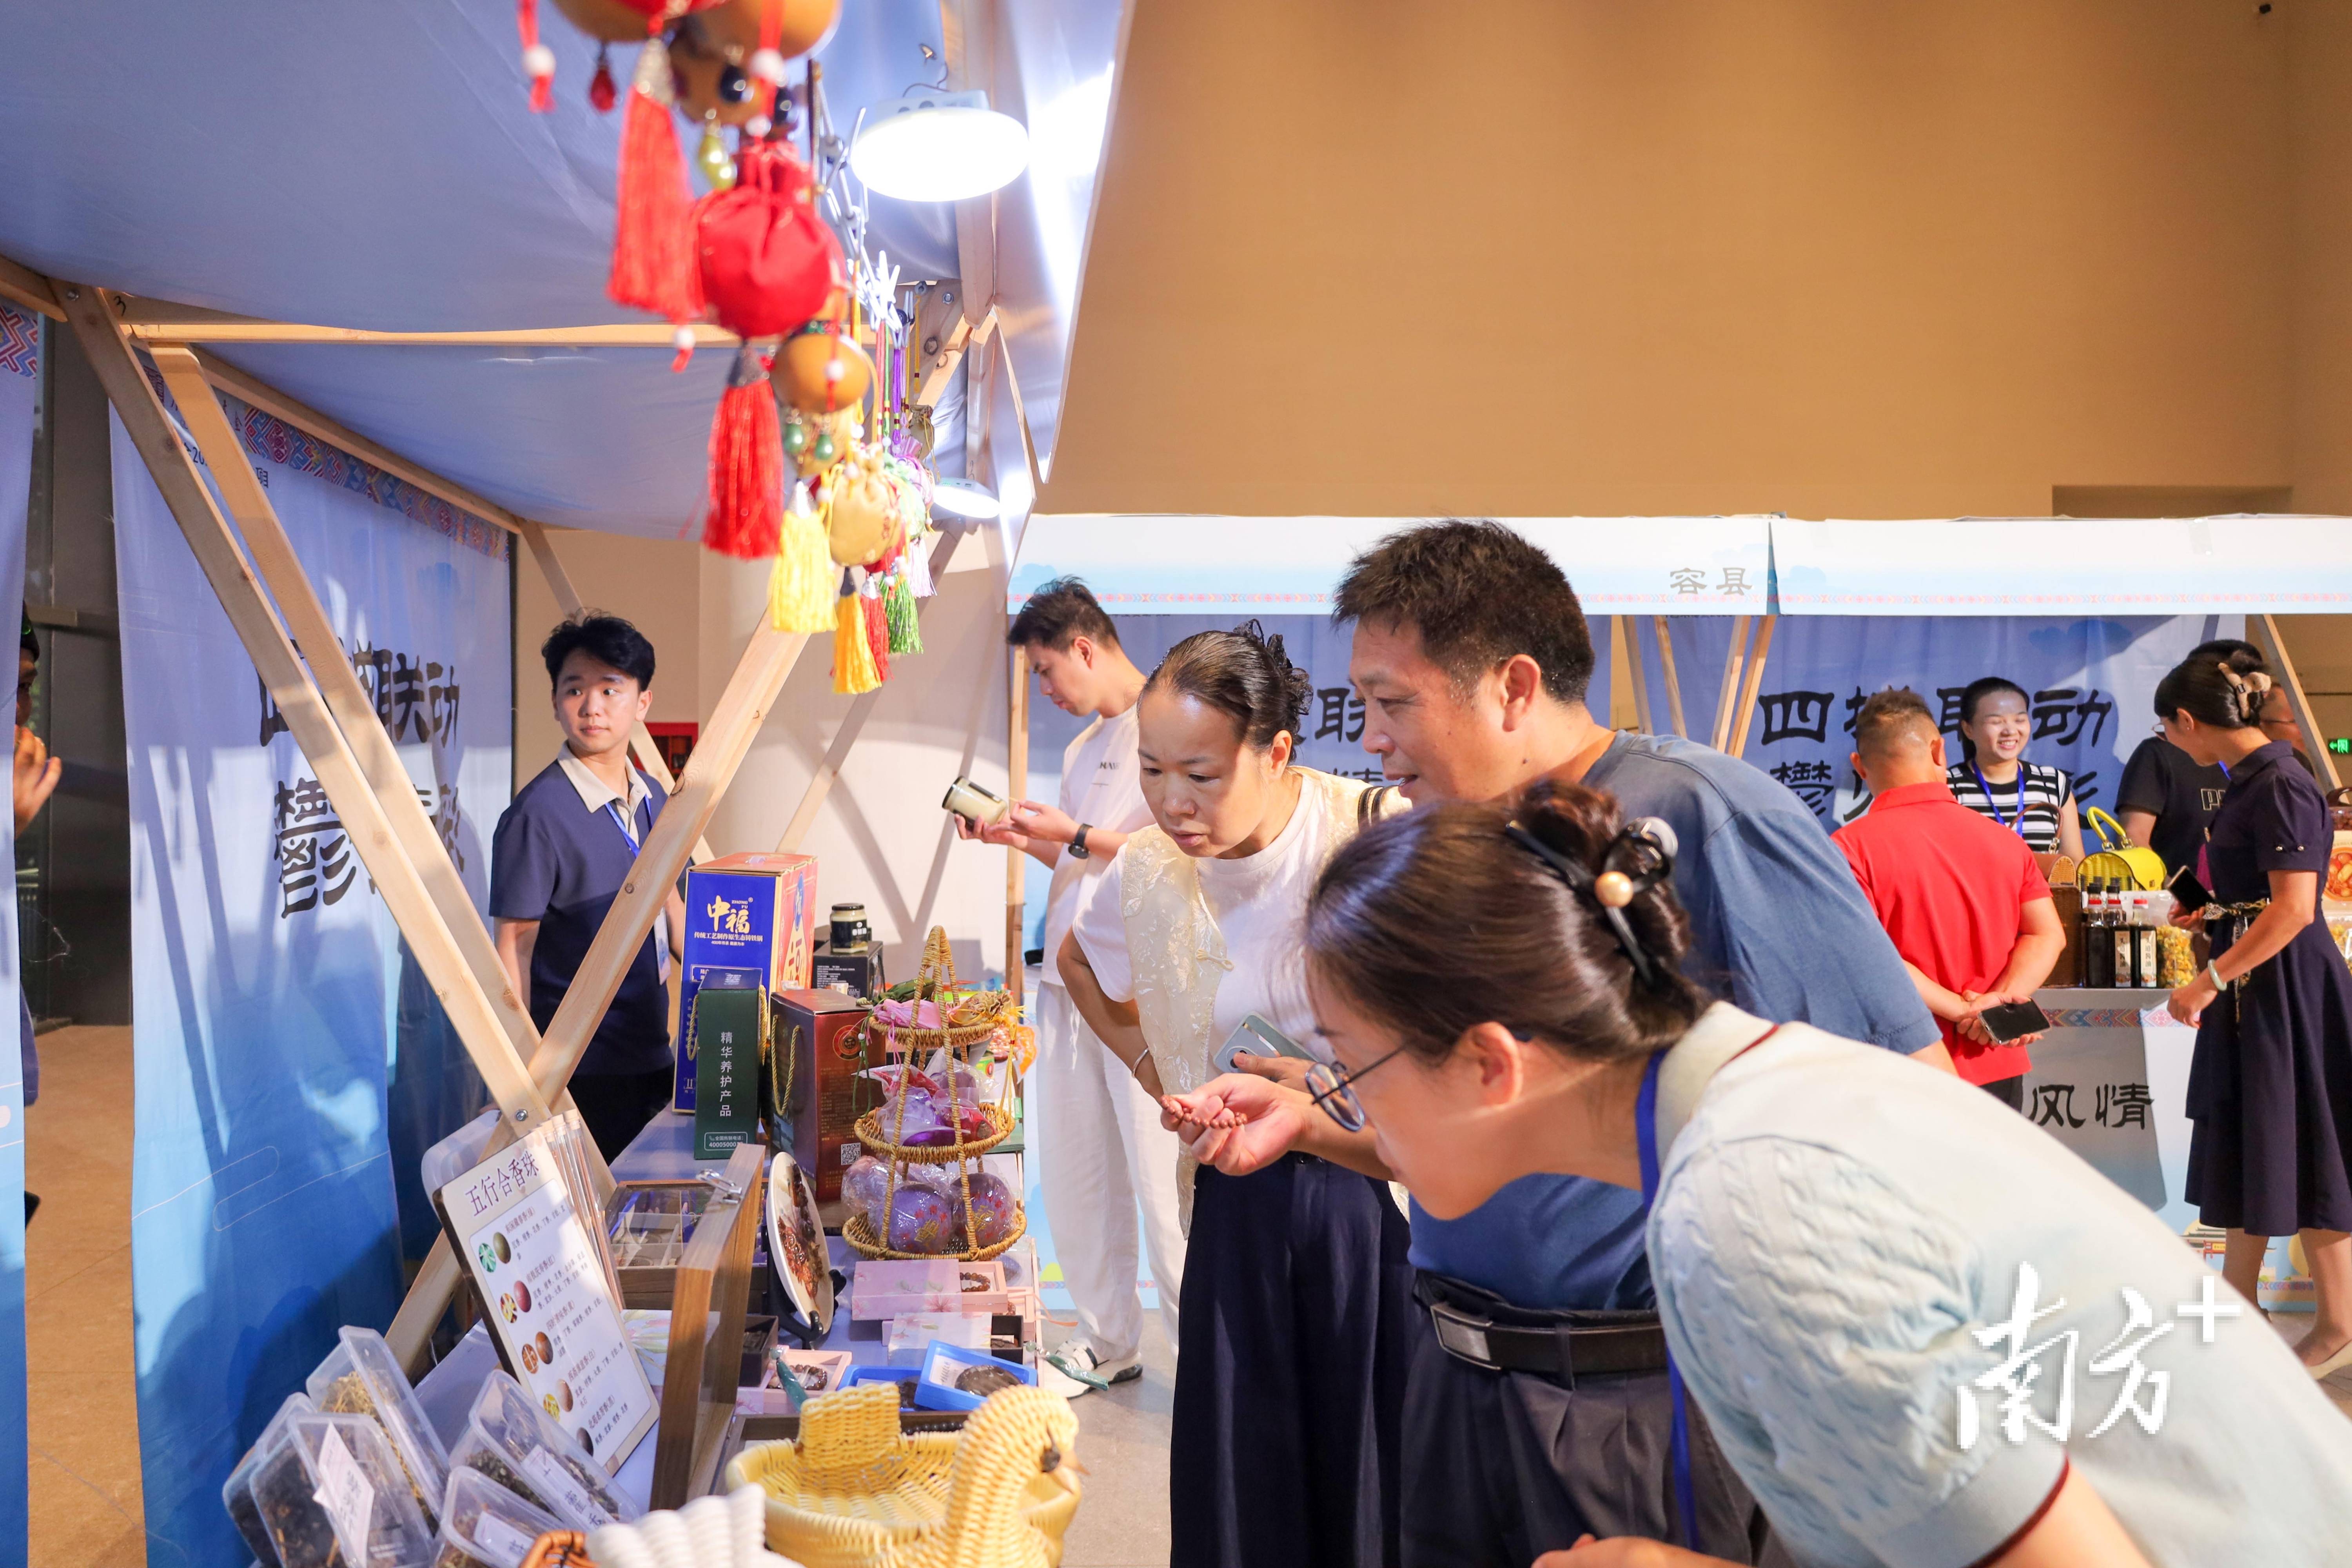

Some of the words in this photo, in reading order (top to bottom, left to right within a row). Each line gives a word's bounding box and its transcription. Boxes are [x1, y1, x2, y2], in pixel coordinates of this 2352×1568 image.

[1670, 567, 1753, 596] 容县
[707, 895, 750, 934] 中福
[720, 1031, 733, 1117] 精华养护产品
[2029, 1083, 2154, 1130] 风情
[465, 1150, 539, 1216] 五行合香珠
